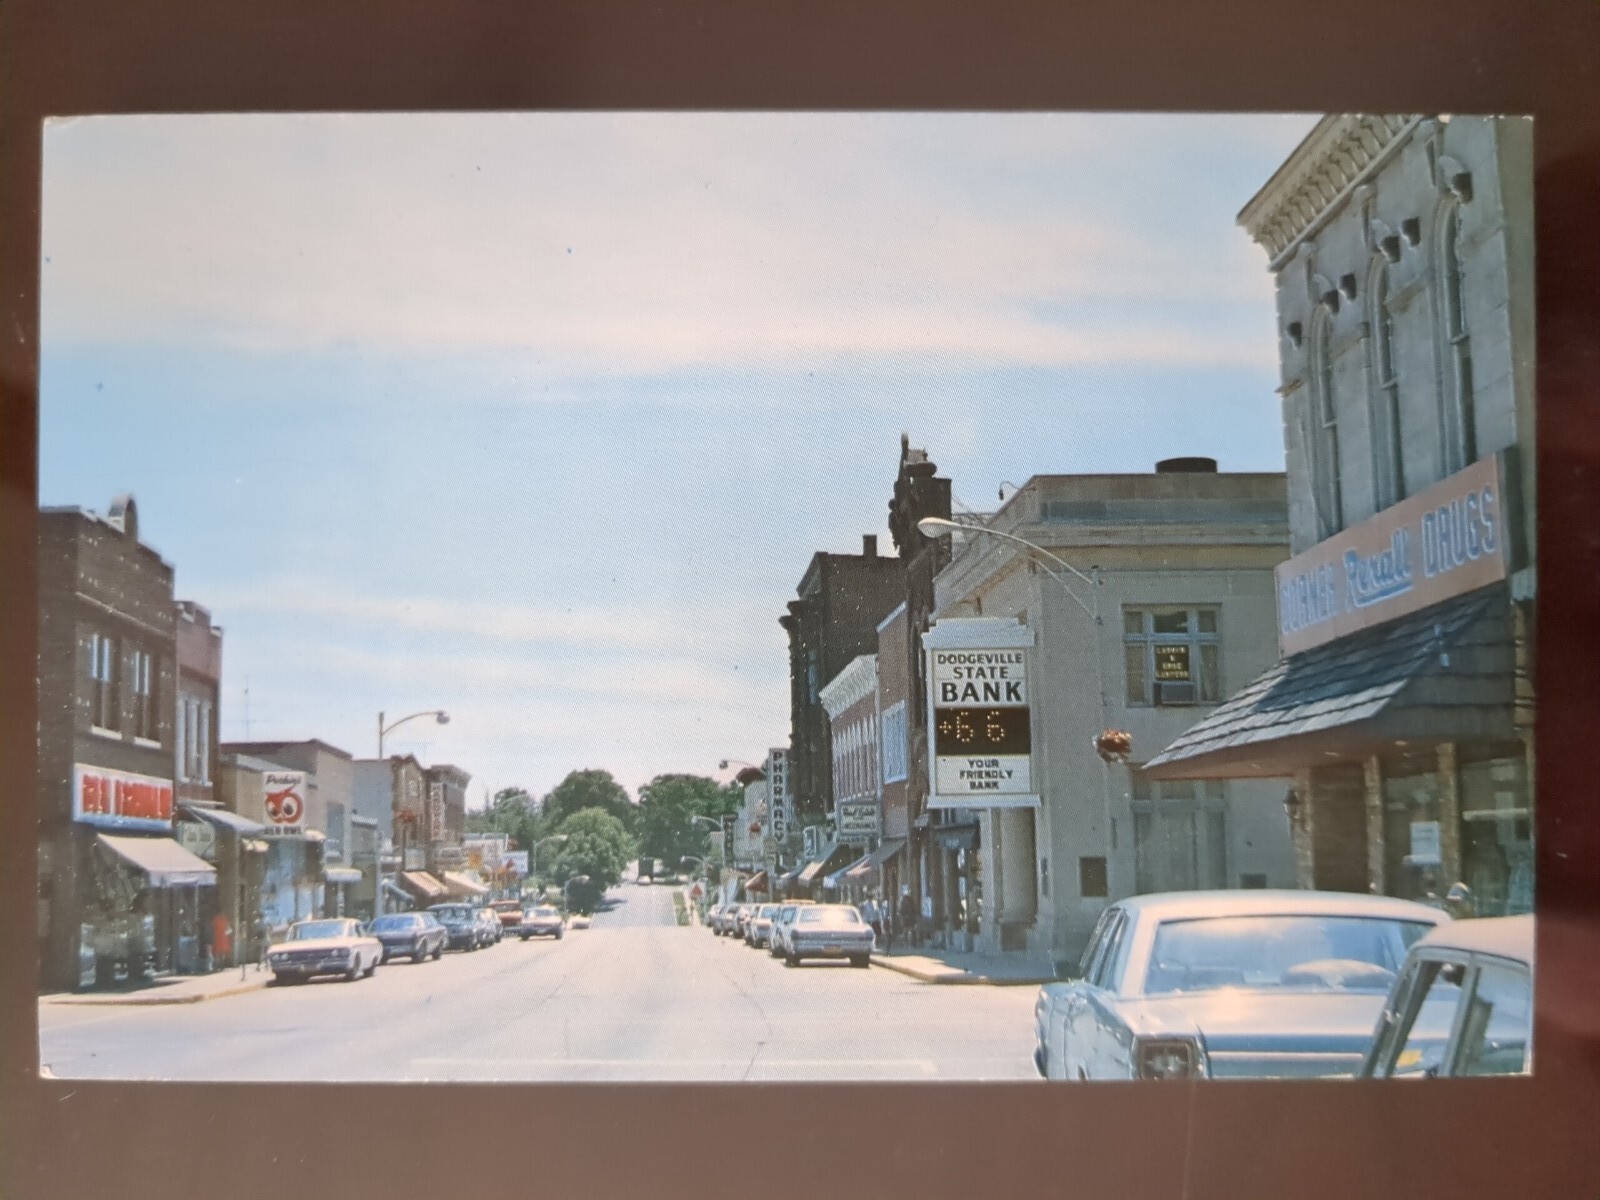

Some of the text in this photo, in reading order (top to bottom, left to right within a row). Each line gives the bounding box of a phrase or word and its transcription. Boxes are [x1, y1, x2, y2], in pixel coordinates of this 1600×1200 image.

[1342, 527, 1413, 608] Rexall
[1421, 484, 1497, 579] DRUGS
[937, 653, 1024, 665] DODGEVILLE
[953, 666, 1009, 680] STATE
[941, 681, 1023, 703] BANK
[967, 758, 1000, 768] YOUR
[959, 769, 1014, 780] FRIENDLY
[969, 780, 1000, 790] BANK
[773, 751, 785, 842] PHARMACY
